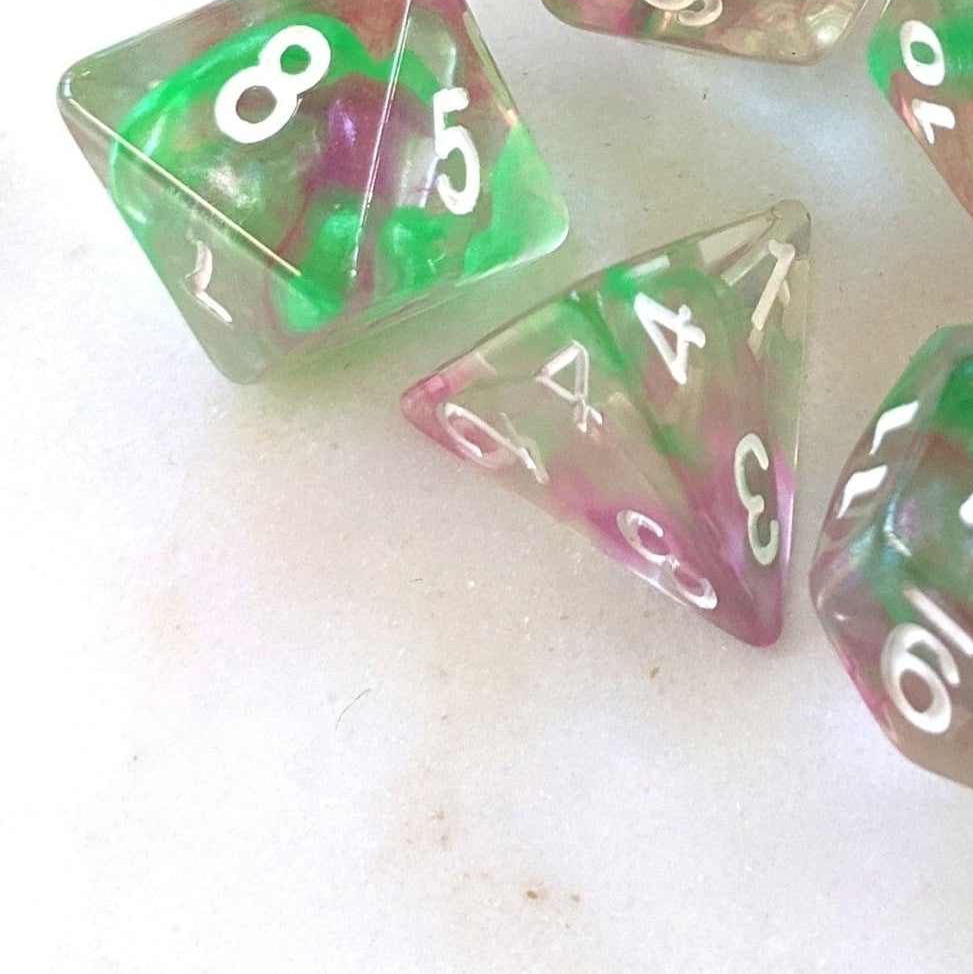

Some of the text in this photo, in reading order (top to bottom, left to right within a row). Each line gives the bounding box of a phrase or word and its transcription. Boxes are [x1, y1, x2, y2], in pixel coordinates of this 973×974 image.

[215, 24, 331, 144] 8
[900, 20, 956, 144] 10
[432, 87, 481, 215] 5
[535, 339, 603, 433] 4
[634, 291, 706, 385] 4
[734, 432, 779, 566] 3
